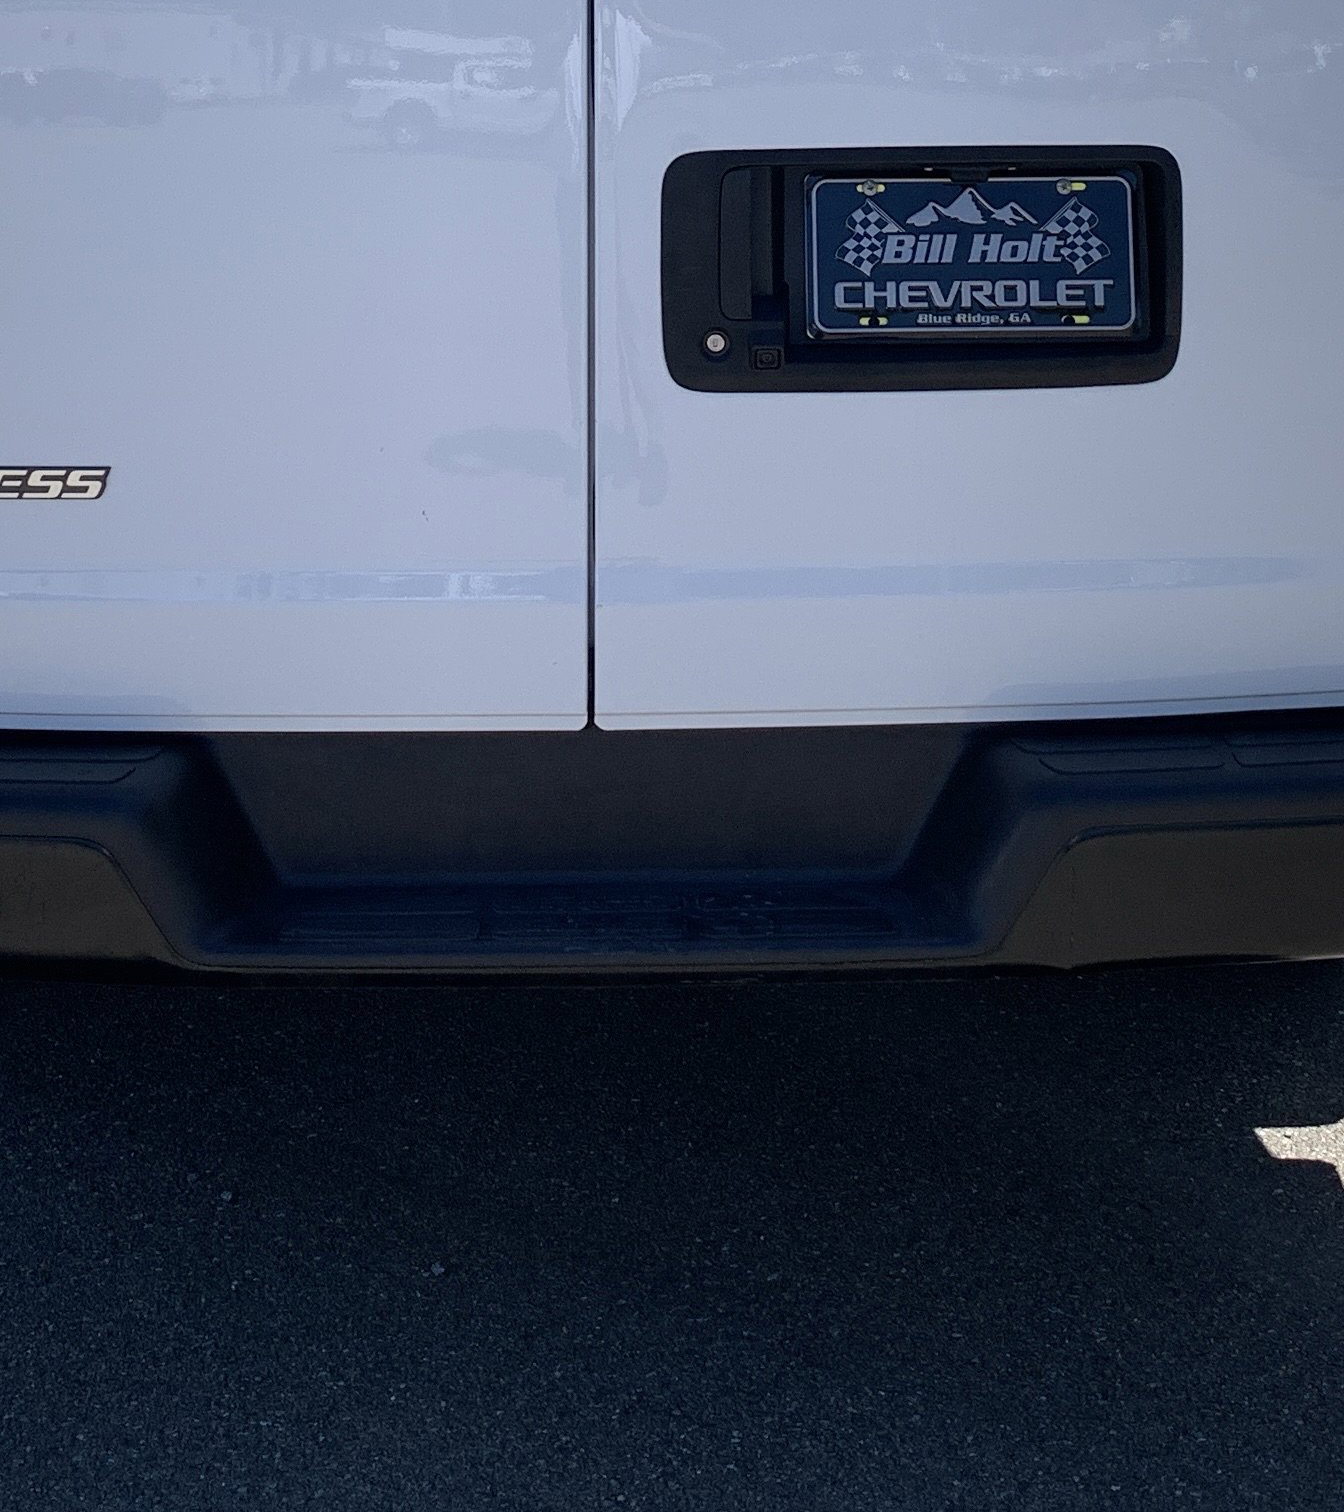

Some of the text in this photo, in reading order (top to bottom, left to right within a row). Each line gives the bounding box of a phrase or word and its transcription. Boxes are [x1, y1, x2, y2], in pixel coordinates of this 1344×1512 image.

[882, 233, 1064, 264] Bill Holt
[834, 279, 1113, 309] CHEVROLET
[917, 312, 1032, 326] Blue Ridge, GA
